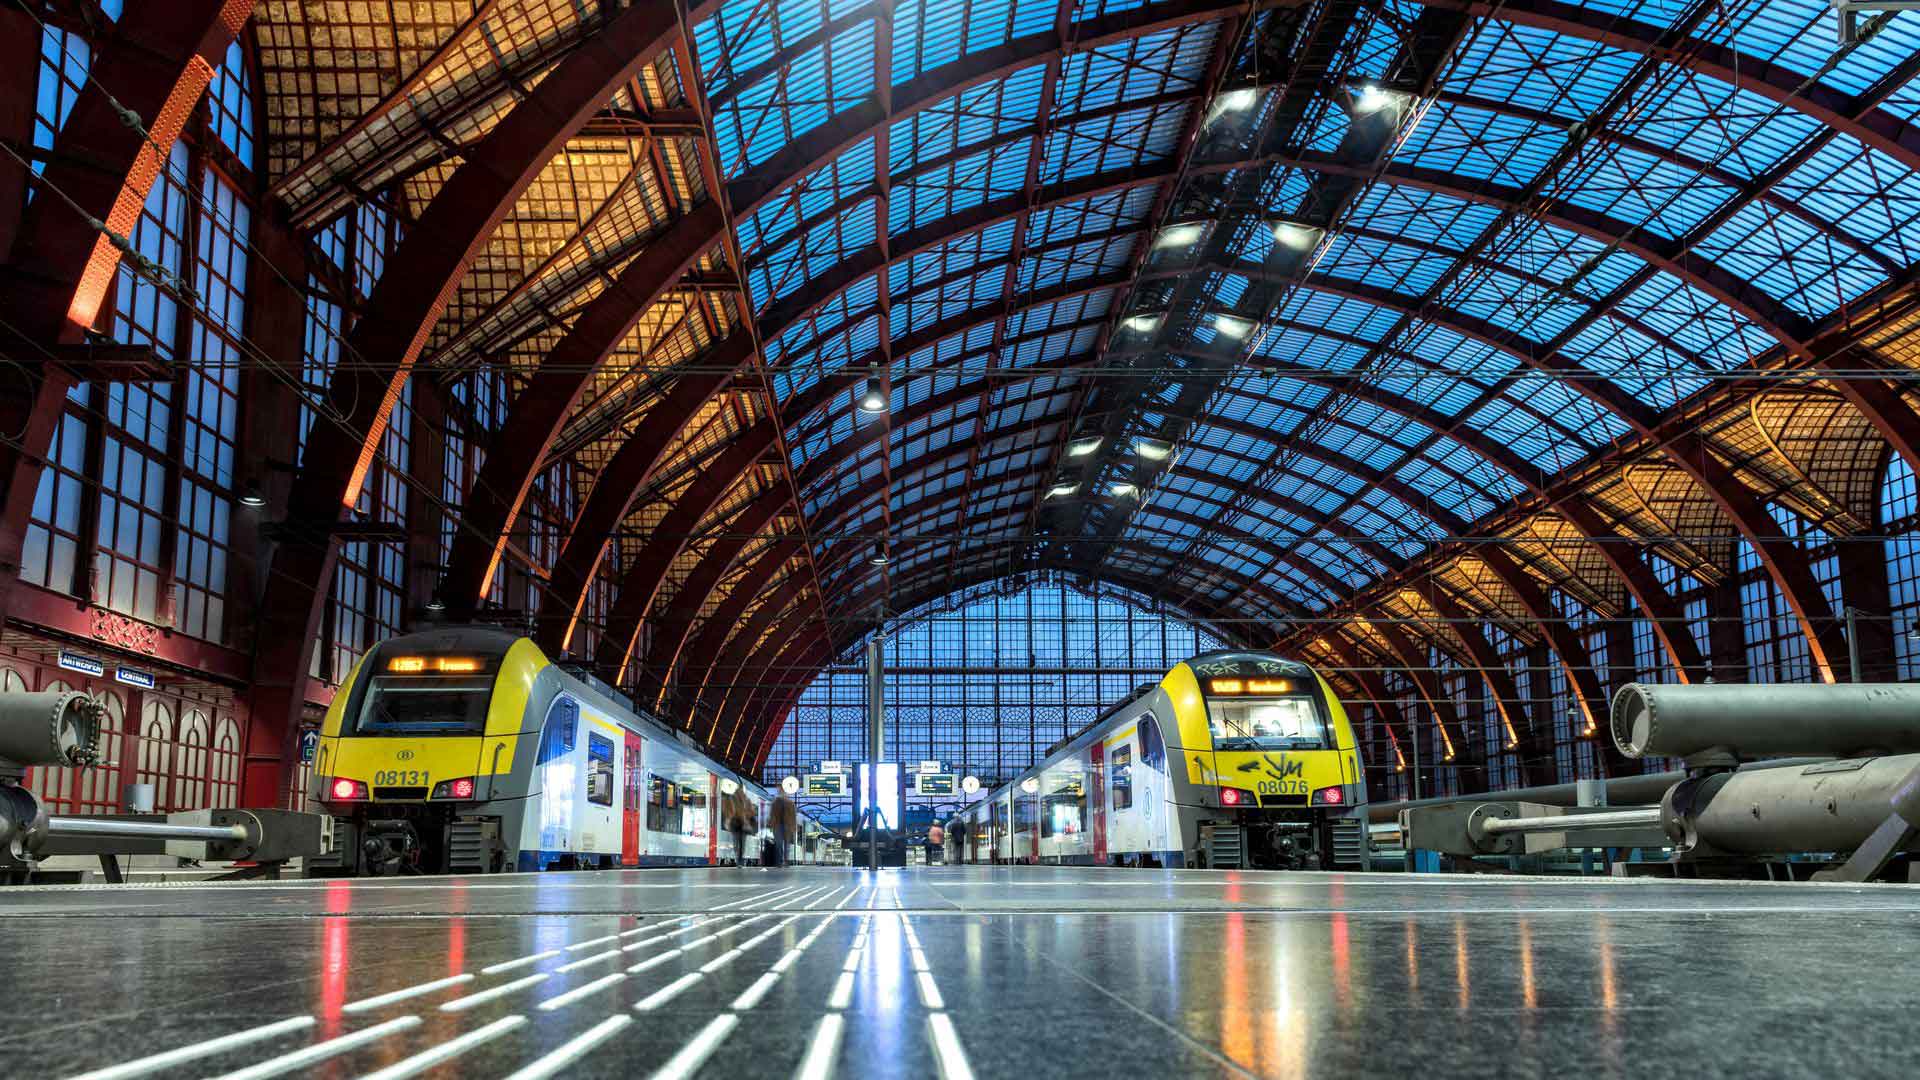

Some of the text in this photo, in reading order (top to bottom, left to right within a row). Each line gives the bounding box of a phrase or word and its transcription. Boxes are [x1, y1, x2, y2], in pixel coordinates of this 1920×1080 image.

[62, 655, 101, 673] ANTWERPEN
[374, 770, 430, 786] 08131
[1257, 780, 1309, 794] 08076
